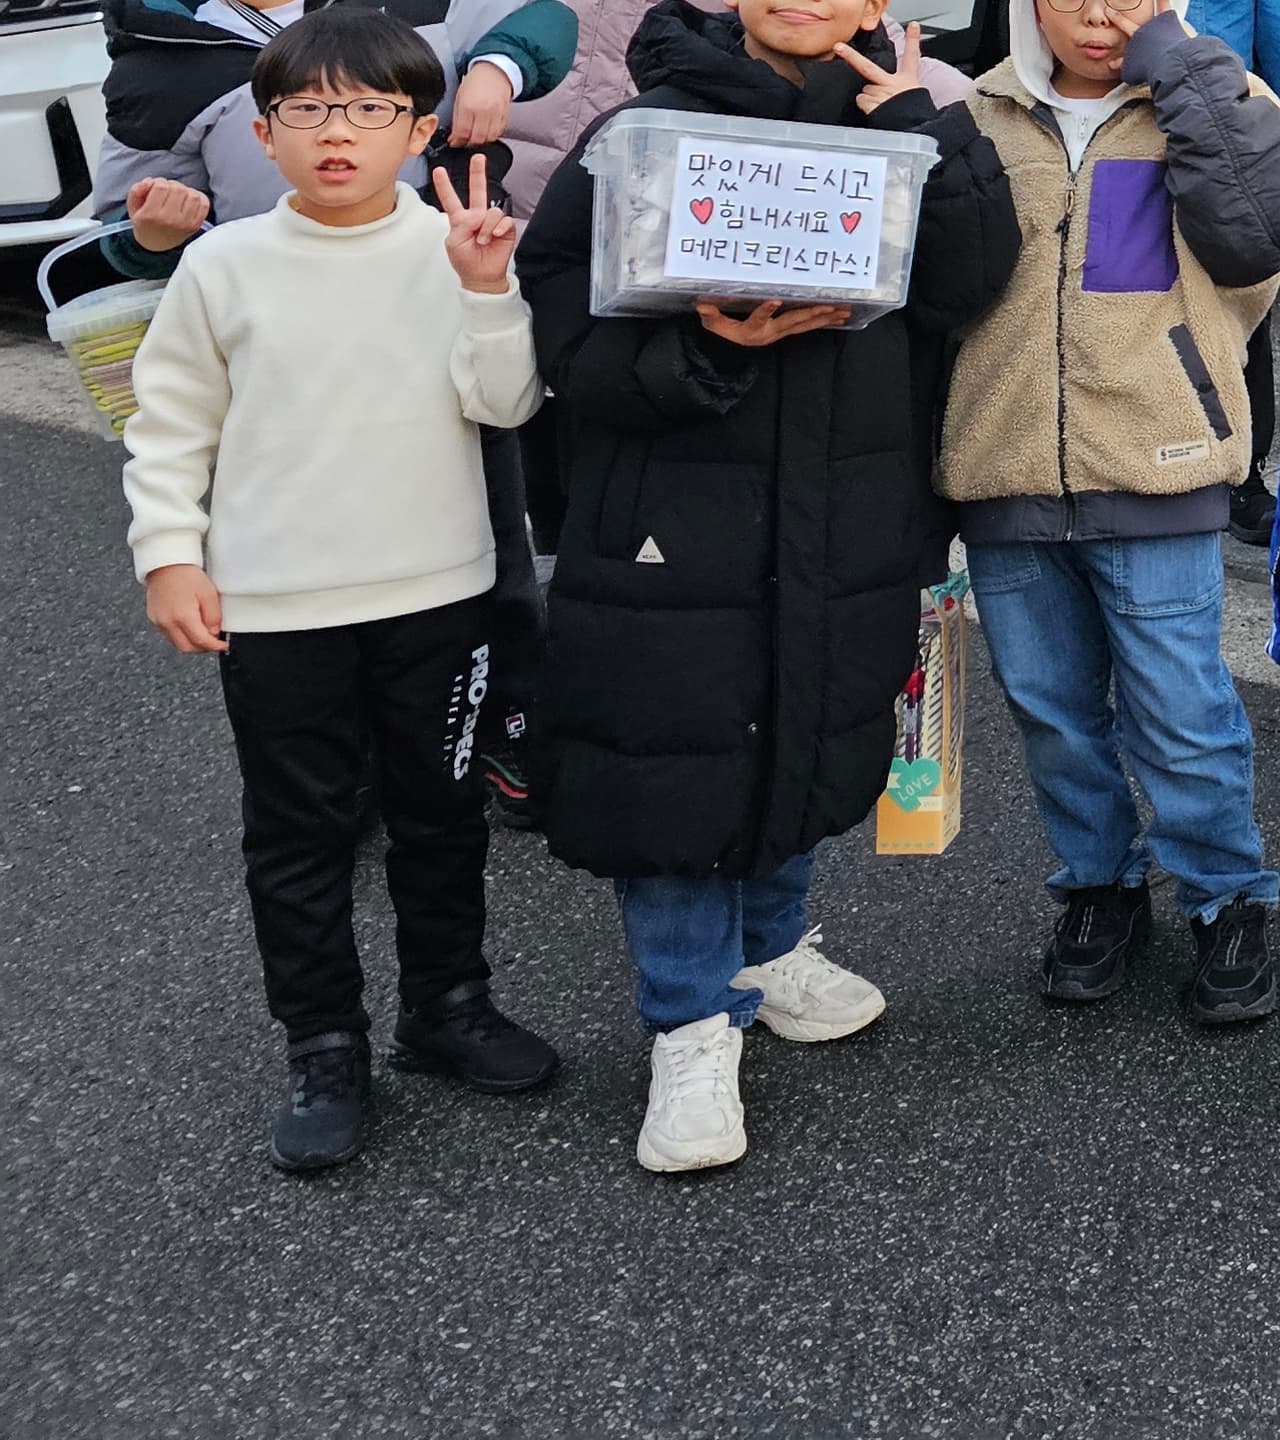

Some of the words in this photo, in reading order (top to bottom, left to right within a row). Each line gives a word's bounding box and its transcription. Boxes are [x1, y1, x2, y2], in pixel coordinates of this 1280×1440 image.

[687, 153, 783, 193] 맛있게
[793, 161, 874, 201] 드시고
[719, 199, 831, 235] 힘내세요
[680, 237, 872, 277] 메리크리스마스!
[897, 773, 933, 803] LOVE
